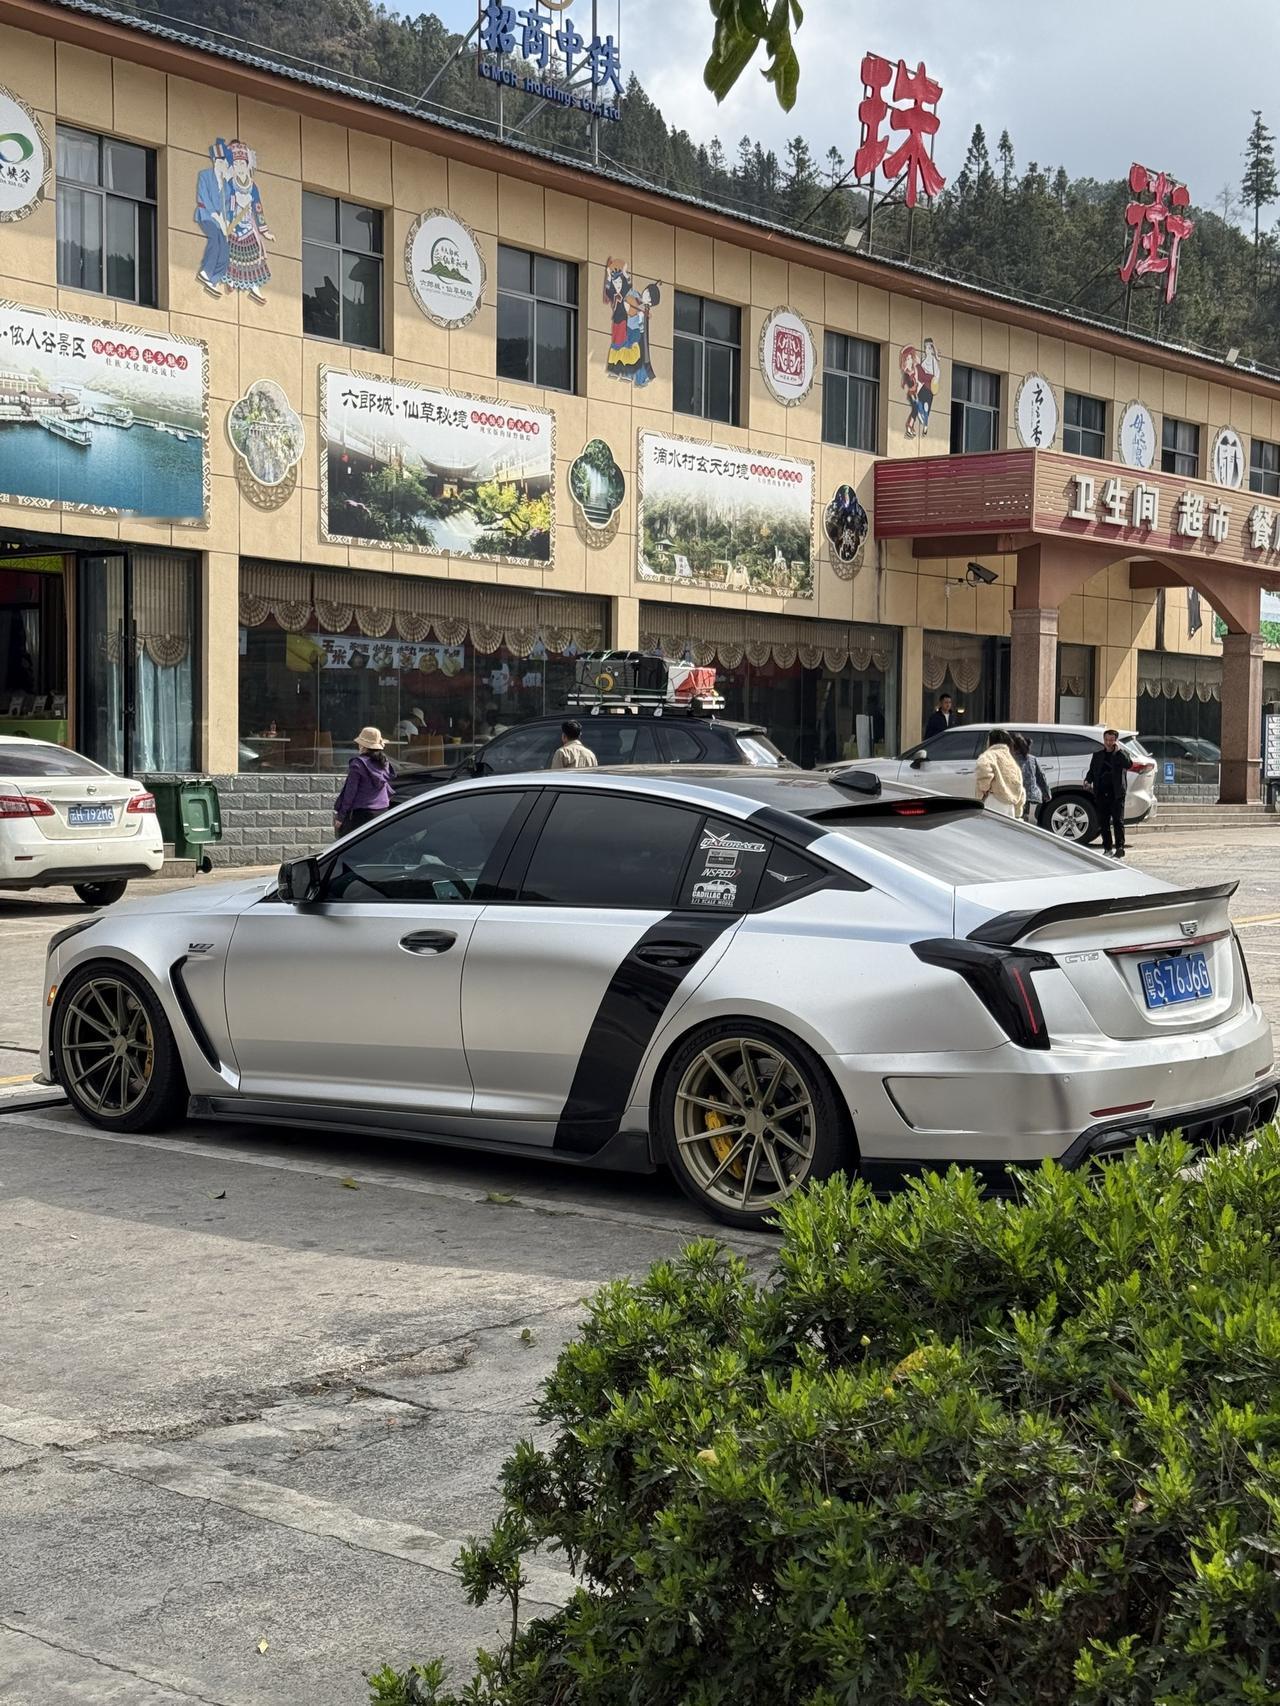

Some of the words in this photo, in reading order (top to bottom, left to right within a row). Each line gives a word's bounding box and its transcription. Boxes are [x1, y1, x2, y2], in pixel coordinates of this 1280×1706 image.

[481, 0, 625, 94] 招商中铁
[855, 56, 947, 208] 珠
[0, 325, 86, 360] ·侬人谷景区
[142, 349, 188, 370] 壮乡魅力
[341, 389, 469, 430] 六郎城·仙草秘境
[653, 446, 749, 480] 滴水村玄天幻境
[1068, 474, 1160, 532] 卫生间
[1177, 490, 1232, 542] 超市
[701, 868, 736, 878] INSPEED
[692, 890, 721, 899] CADILLAC
[1145, 960, 1209, 999] 粤S·76J6G
